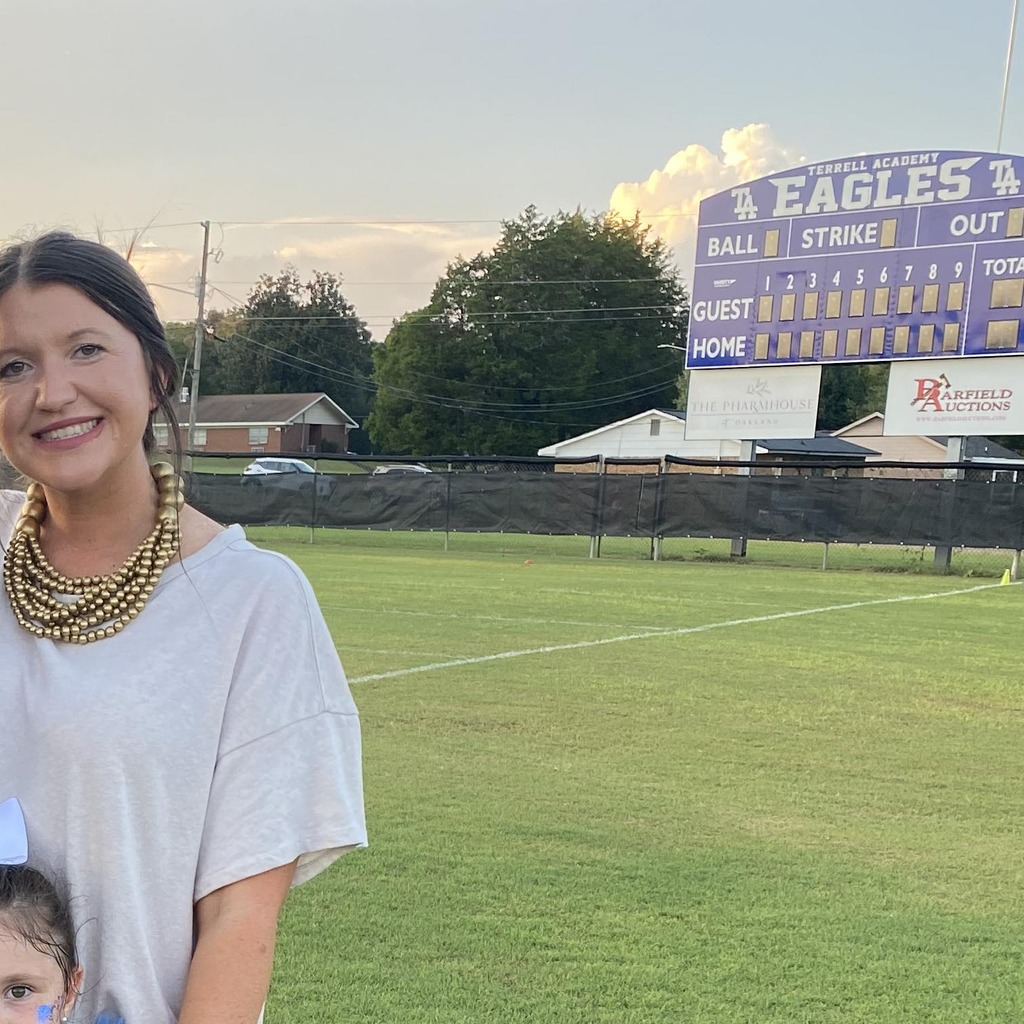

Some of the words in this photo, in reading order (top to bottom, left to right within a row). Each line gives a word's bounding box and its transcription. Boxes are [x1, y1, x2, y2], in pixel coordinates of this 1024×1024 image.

[808, 161, 867, 176] TERRELL
[872, 152, 939, 169] ACADEMY
[768, 157, 983, 217] EAGLES
[801, 222, 878, 249] STRIKE
[950, 211, 1004, 236] OUT
[707, 234, 758, 257] BALL
[765, 275, 771, 291] 1
[786, 274, 794, 290] 2
[809, 272, 817, 288] 3
[832, 270, 841, 286] 4
[856, 269, 864, 285] 5
[880, 267, 888, 283] 6
[905, 265, 913, 281] 7
[929, 264, 937, 280] 8
[955, 262, 963, 278] 9
[693, 298, 754, 322] GUEST
[692, 336, 747, 359] HOME
[913, 378, 1013, 401] BARFIELD
[918, 388, 1011, 412] AUCTIONS
[691, 401, 716, 412] THE
[723, 399, 815, 413] PHARMHOUSE
